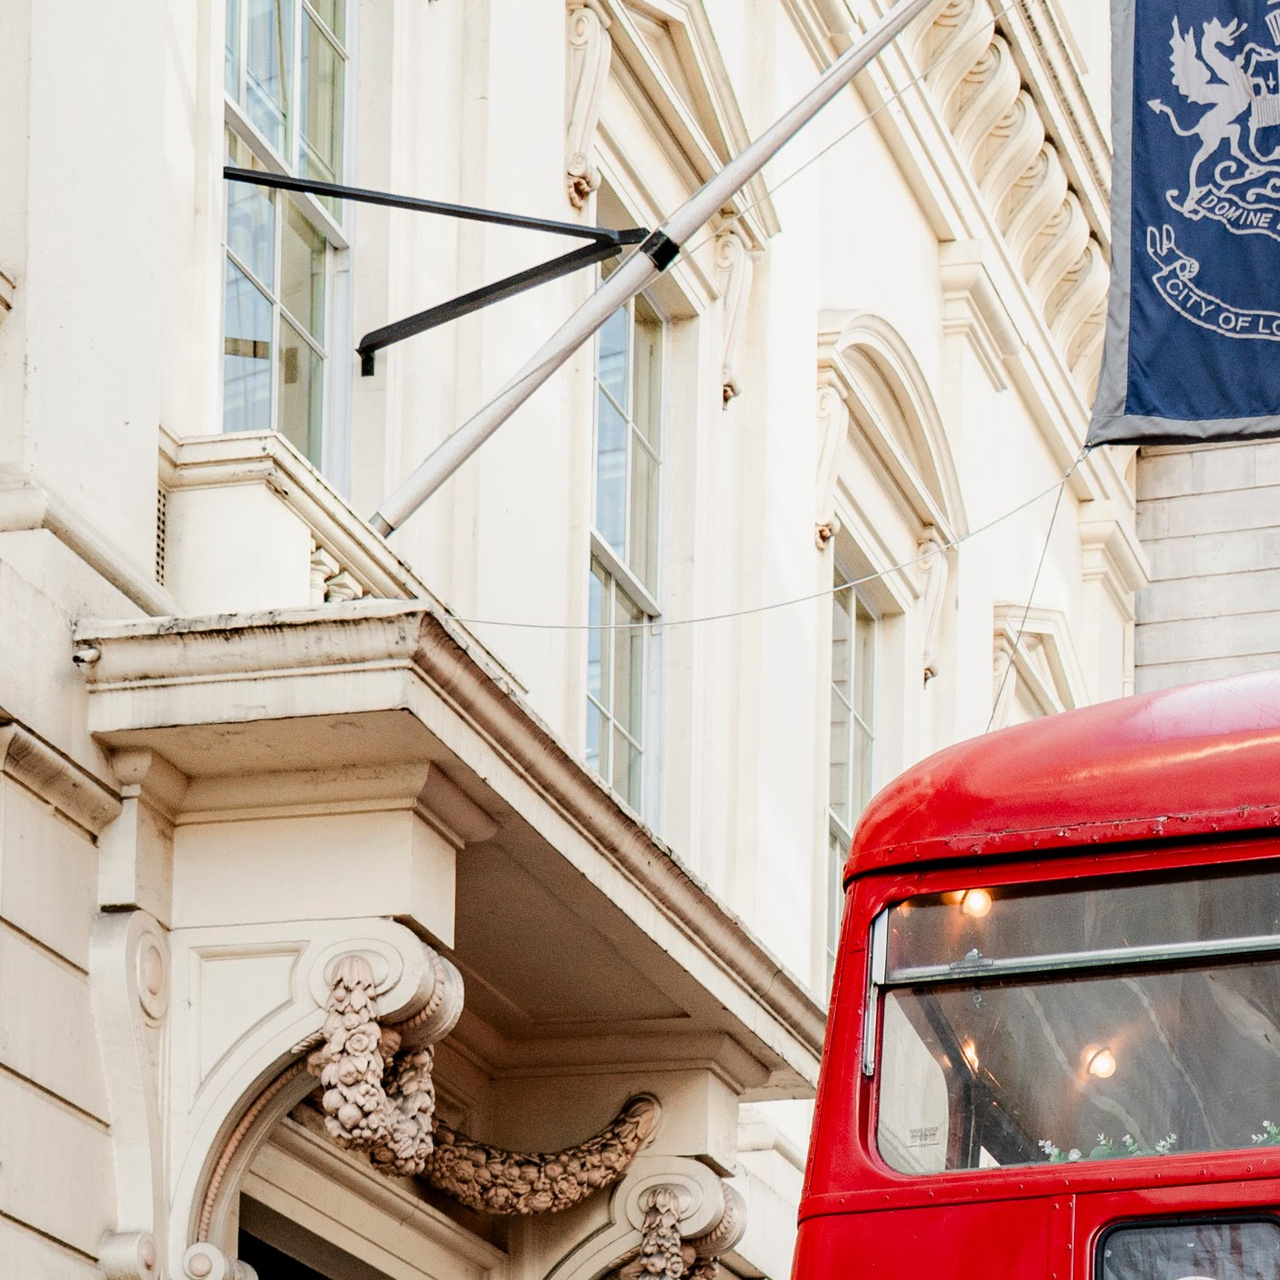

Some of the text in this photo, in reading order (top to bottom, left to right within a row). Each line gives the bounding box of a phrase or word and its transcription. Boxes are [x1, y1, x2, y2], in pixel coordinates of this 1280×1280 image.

[1201, 194, 1273, 228] DOMINE
[1166, 278, 1216, 317] CITY
[1218, 311, 1252, 332] OF
